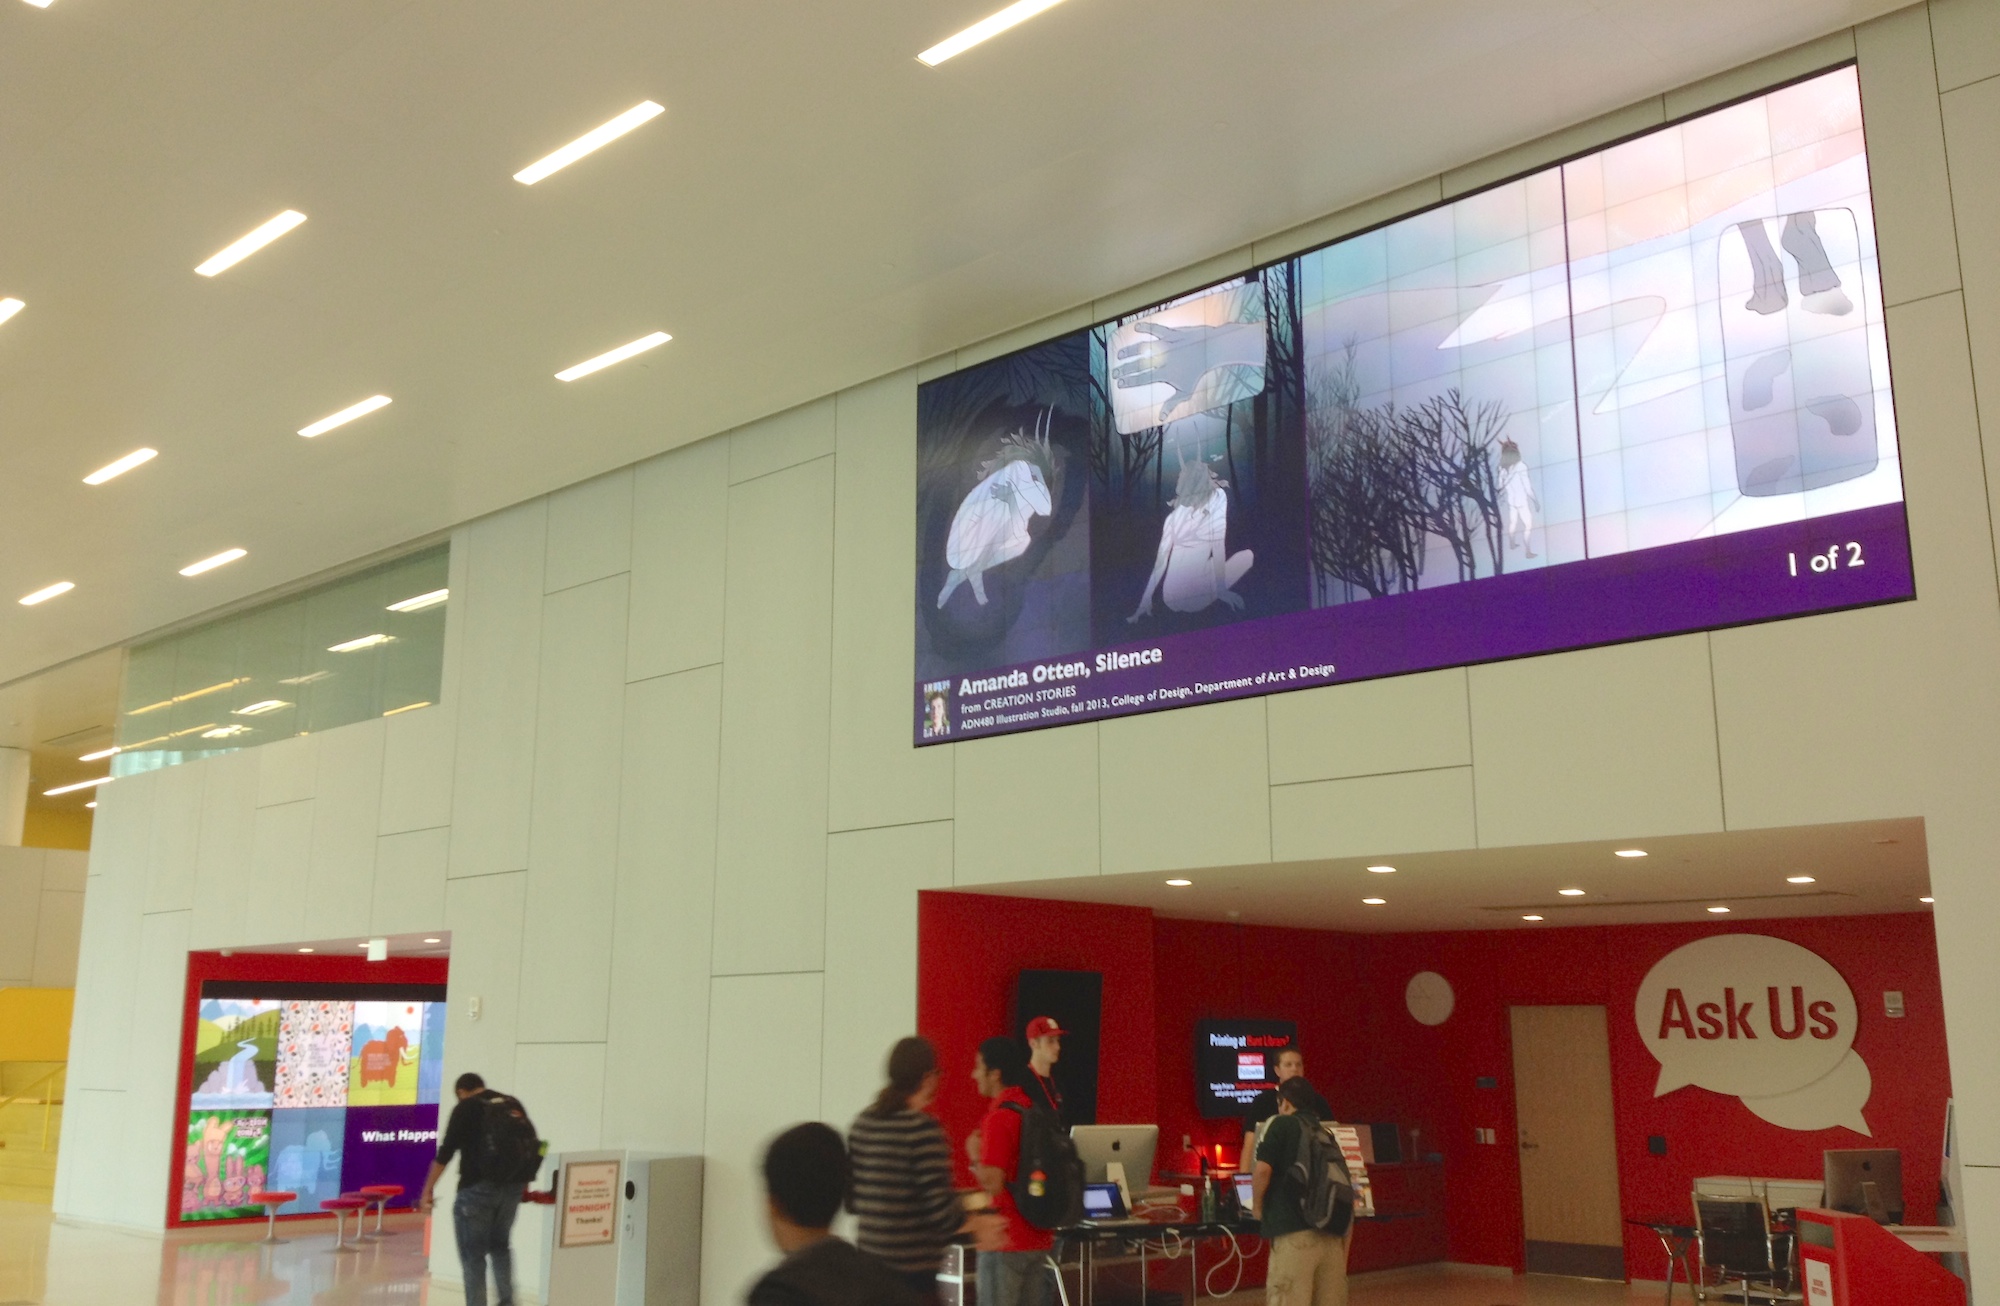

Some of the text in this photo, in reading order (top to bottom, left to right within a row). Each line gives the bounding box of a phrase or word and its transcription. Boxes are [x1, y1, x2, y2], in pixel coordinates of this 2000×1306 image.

[1810, 544, 1840, 573] of
[1846, 541, 1865, 567] 2
[958, 669, 1029, 697] Amanda
[1032, 661, 1091, 683] Otten,
[1095, 647, 1163, 673] Silence
[960, 685, 1077, 715] from CREATION STORIES
[961, 663, 1336, 731] ADN480 Illustration Studio, fall 2013, College of Design, Department of Art & Design
[1658, 985, 1839, 1040] Ask Us
[1209, 1032, 1239, 1050] Printing
[1238, 1035, 1247, 1047] at
[362, 1130, 396, 1142] What
[569, 1202, 612, 1214] MIDNIGHT
